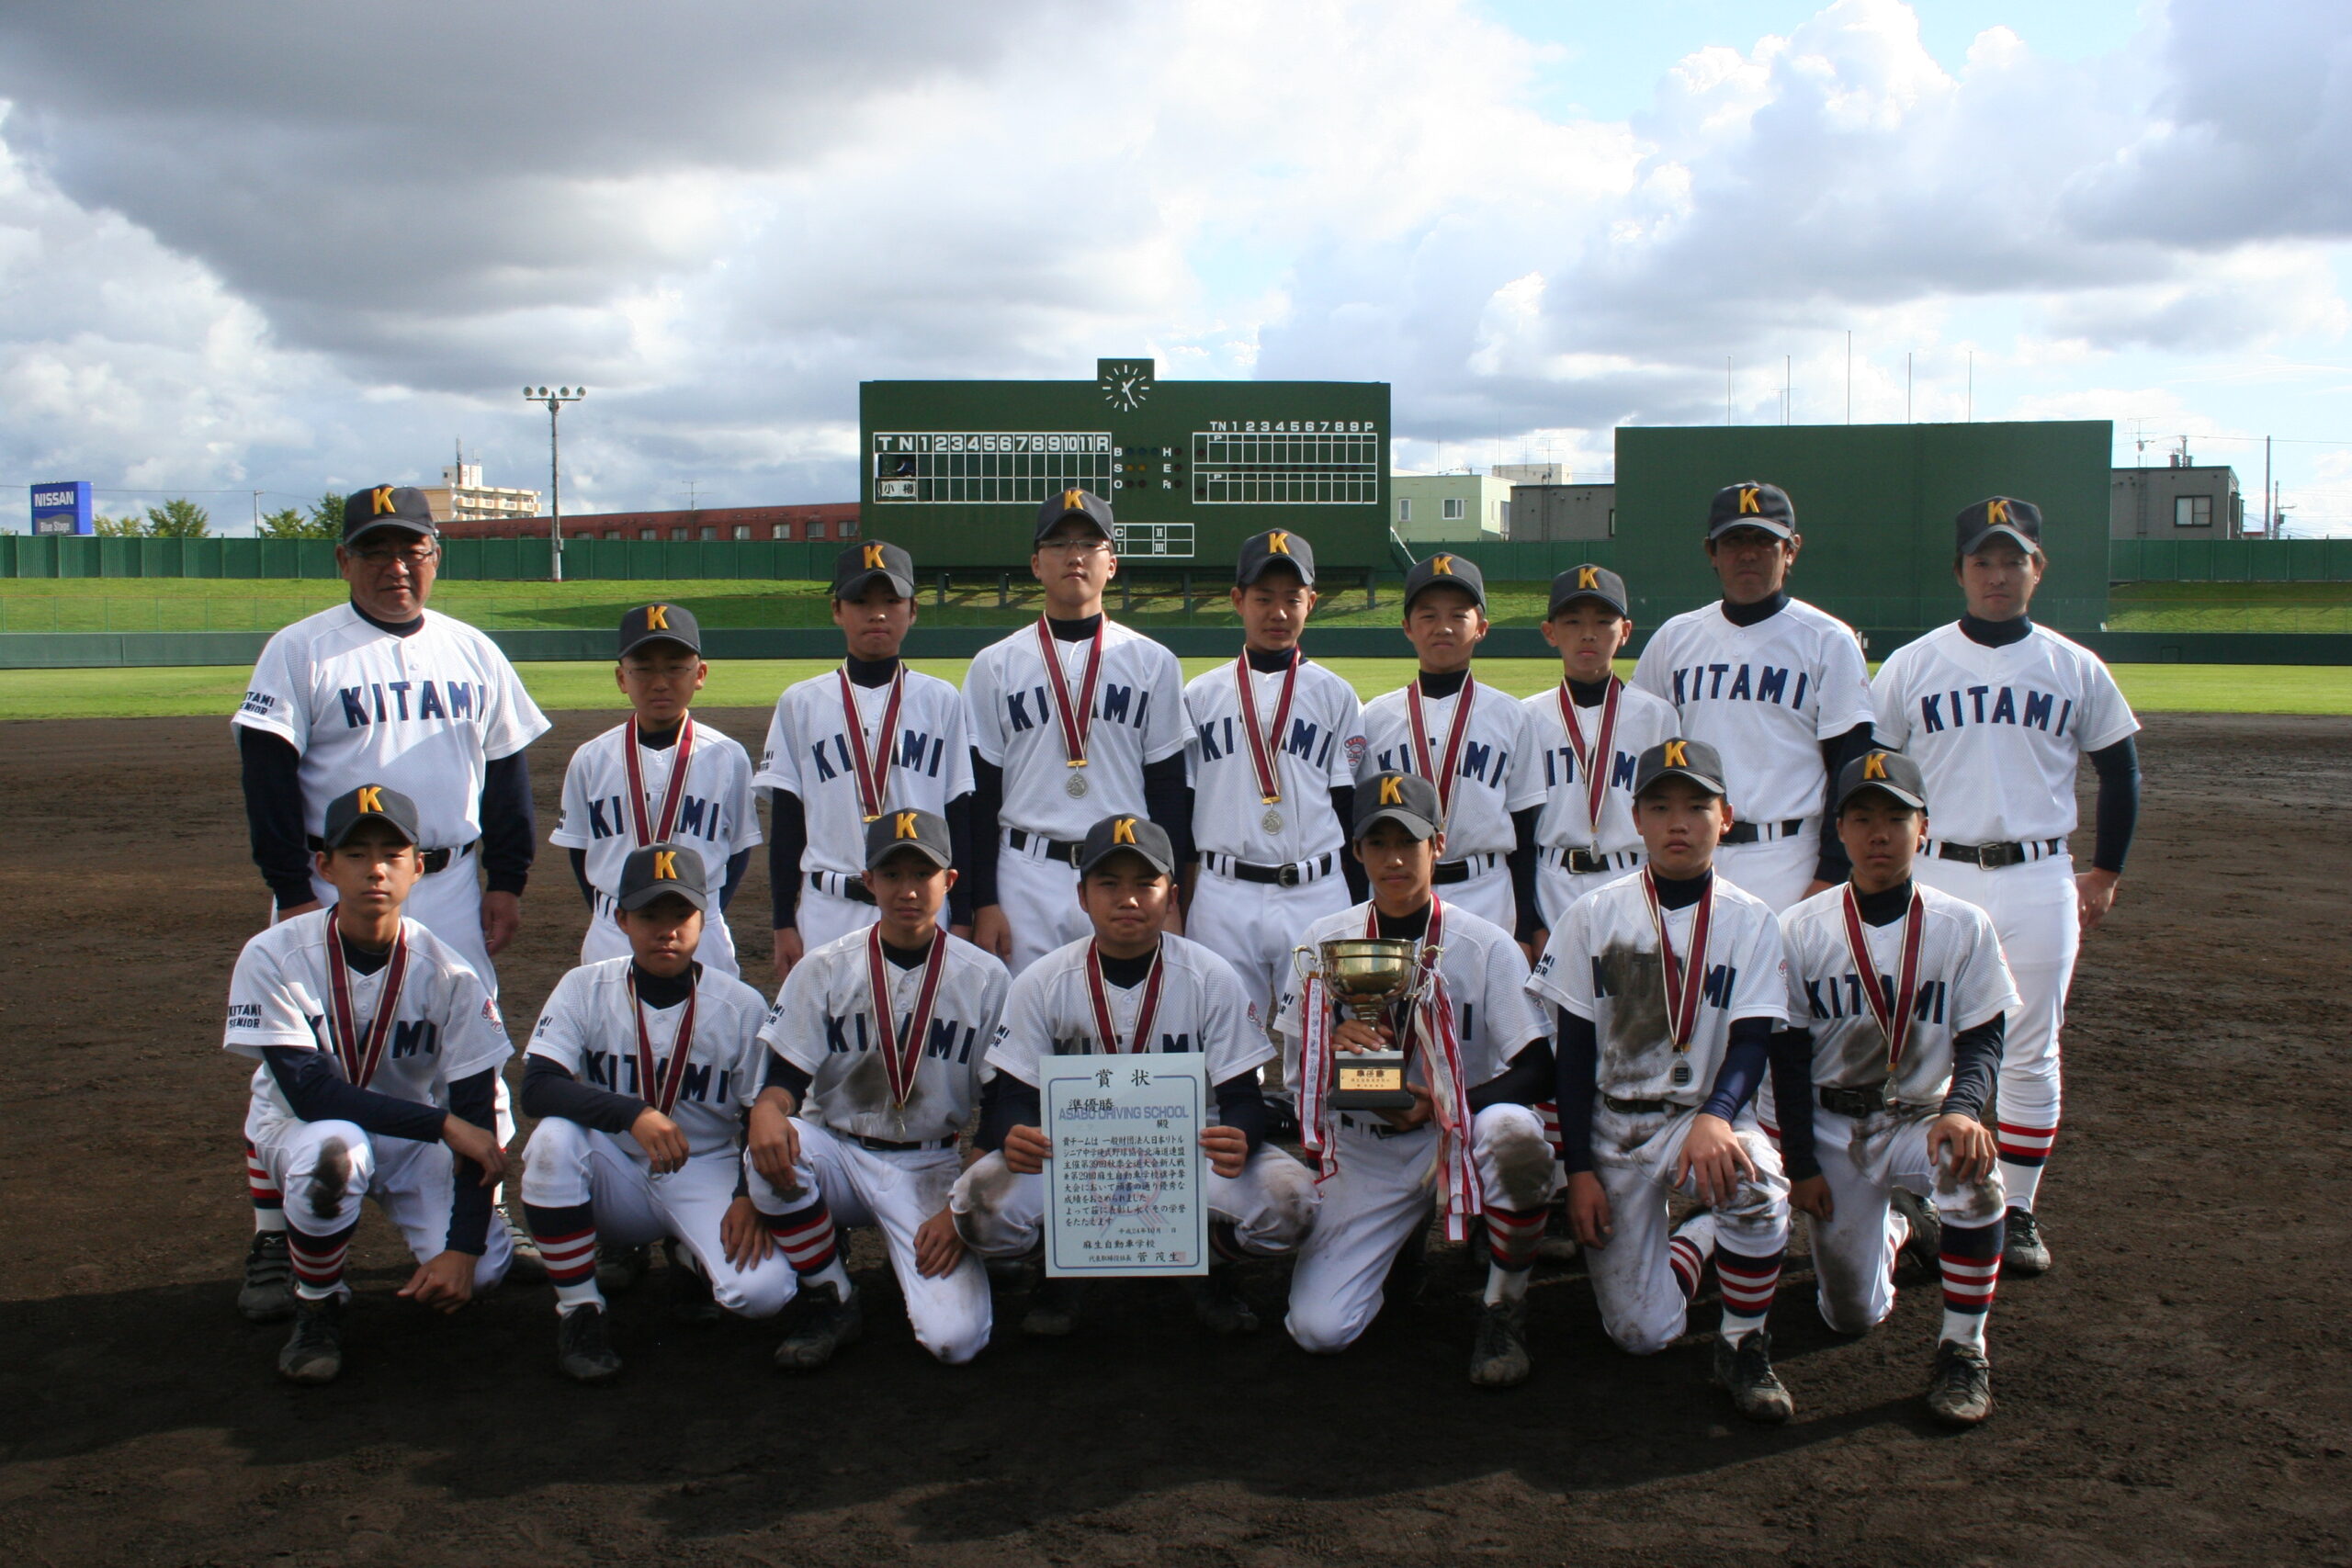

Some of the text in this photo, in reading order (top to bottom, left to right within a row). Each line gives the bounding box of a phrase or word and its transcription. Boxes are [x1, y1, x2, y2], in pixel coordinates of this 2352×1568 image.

[1209, 422, 1374, 432] TN 1 2 3 4 5 6 7 8 9 P
[921, 435, 928, 451] 1
[934, 435, 947, 451] 2
[951, 435, 964, 451] 3
[967, 435, 979, 451] 4
[983, 435, 996, 451] 5
[1000, 435, 1012, 451] 6
[1015, 435, 1028, 451] 7
[1032, 435, 1045, 451] 8
[1048, 435, 1060, 451] 9
[1064, 435, 1078, 451] 10
[1080, 435, 1093, 451] 11
[1096, 435, 1109, 451] R
[1114, 447, 1123, 457] B
[1162, 447, 1171, 457] H
[1114, 463, 1123, 473] S
[1162, 463, 1171, 473] E
[35, 491, 74, 507] NISSAN
[372, 487, 396, 514] K
[1064, 491, 1084, 510] K
[1739, 489, 1760, 513] K
[1987, 501, 2009, 524] K
[40, 522, 52, 532] Blue
[1114, 529, 1124, 537] C
[1155, 528, 1164, 537] II
[1155, 543, 1164, 552] III
[1268, 533, 1290, 555] K
[863, 545, 887, 569] K
[1432, 557, 1453, 575] K
[1577, 568, 1600, 590] K
[646, 605, 669, 631] K
[1672, 663, 1807, 710] KITAMI
[340, 681, 485, 728] KITAMI
[1007, 680, 1149, 733] KIMI
[1921, 685, 2072, 738] KITAMI
[1199, 715, 1333, 768] KIMI
[811, 728, 944, 784] KIMI
[1664, 740, 1688, 768] K
[1863, 754, 1887, 780] K
[357, 786, 384, 814] K
[1380, 776, 1404, 805] K
[588, 793, 719, 841] KIMI
[896, 813, 919, 840] K
[1113, 818, 1137, 844] K
[654, 852, 678, 880] K
[229, 1017, 260, 1028] SENIOR
[1095, 1068, 1150, 1088] 賞状
[1069, 1098, 1114, 1112] 準優勝
[1099, 1106, 1141, 1120] DRIVING
[1144, 1105, 1189, 1119] SCHOOL
